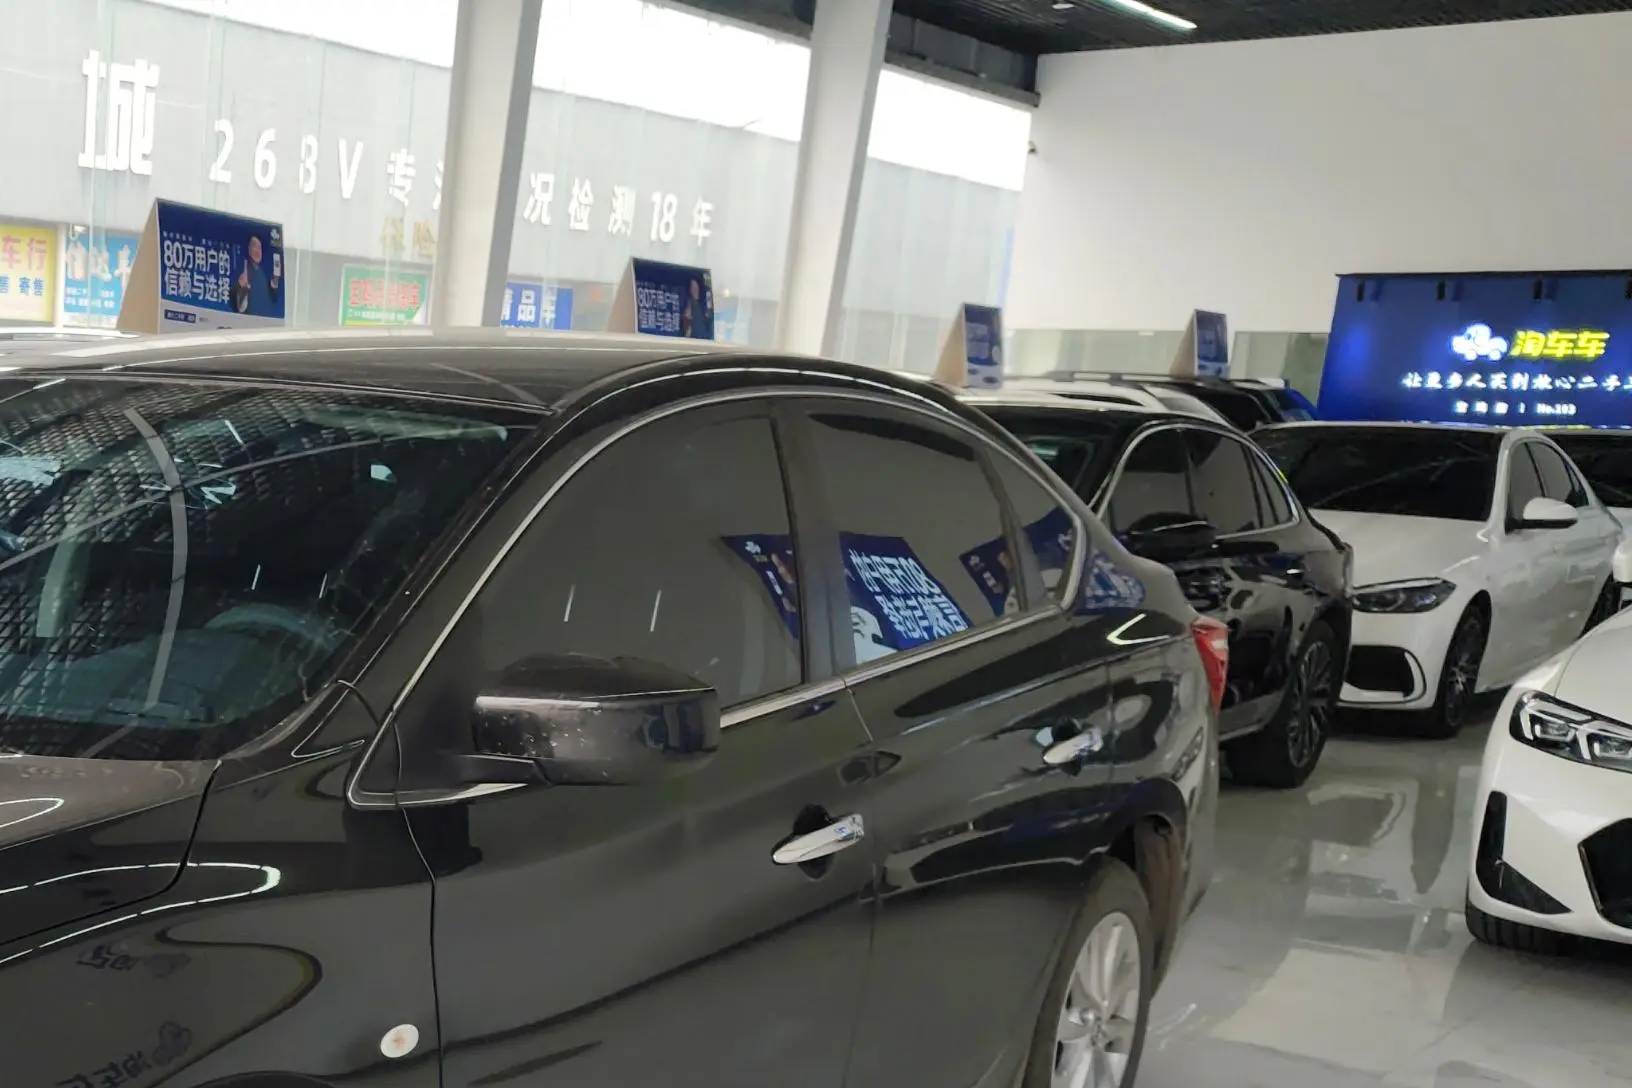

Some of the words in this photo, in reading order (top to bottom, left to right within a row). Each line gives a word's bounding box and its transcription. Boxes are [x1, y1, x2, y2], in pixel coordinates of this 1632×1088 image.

[164, 240, 230, 276] 80万用户的
[165, 266, 230, 304] 信赖与选择
[1509, 328, 1609, 360] 淘车车
